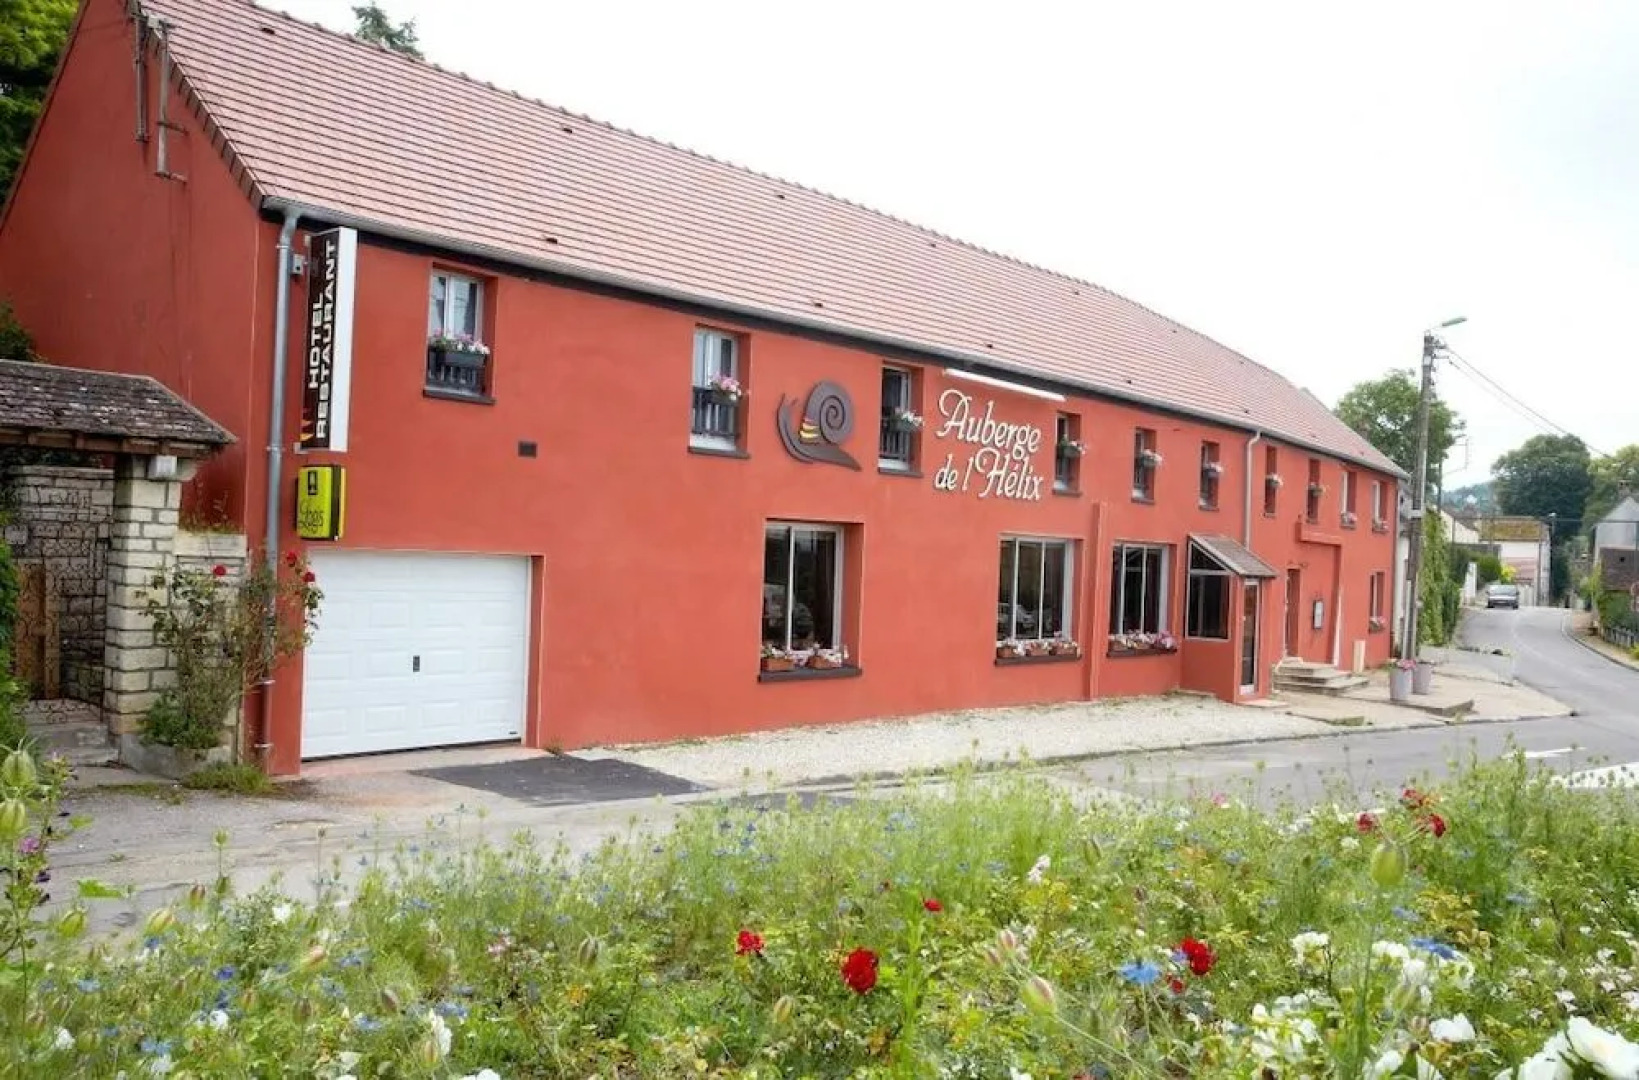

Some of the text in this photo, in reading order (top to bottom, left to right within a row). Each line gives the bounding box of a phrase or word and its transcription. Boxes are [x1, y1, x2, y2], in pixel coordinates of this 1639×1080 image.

[308, 292, 324, 389] HOTEL
[316, 240, 336, 438] RESTAURANT
[936, 389, 1041, 460] Auberge
[935, 453, 958, 491] de
